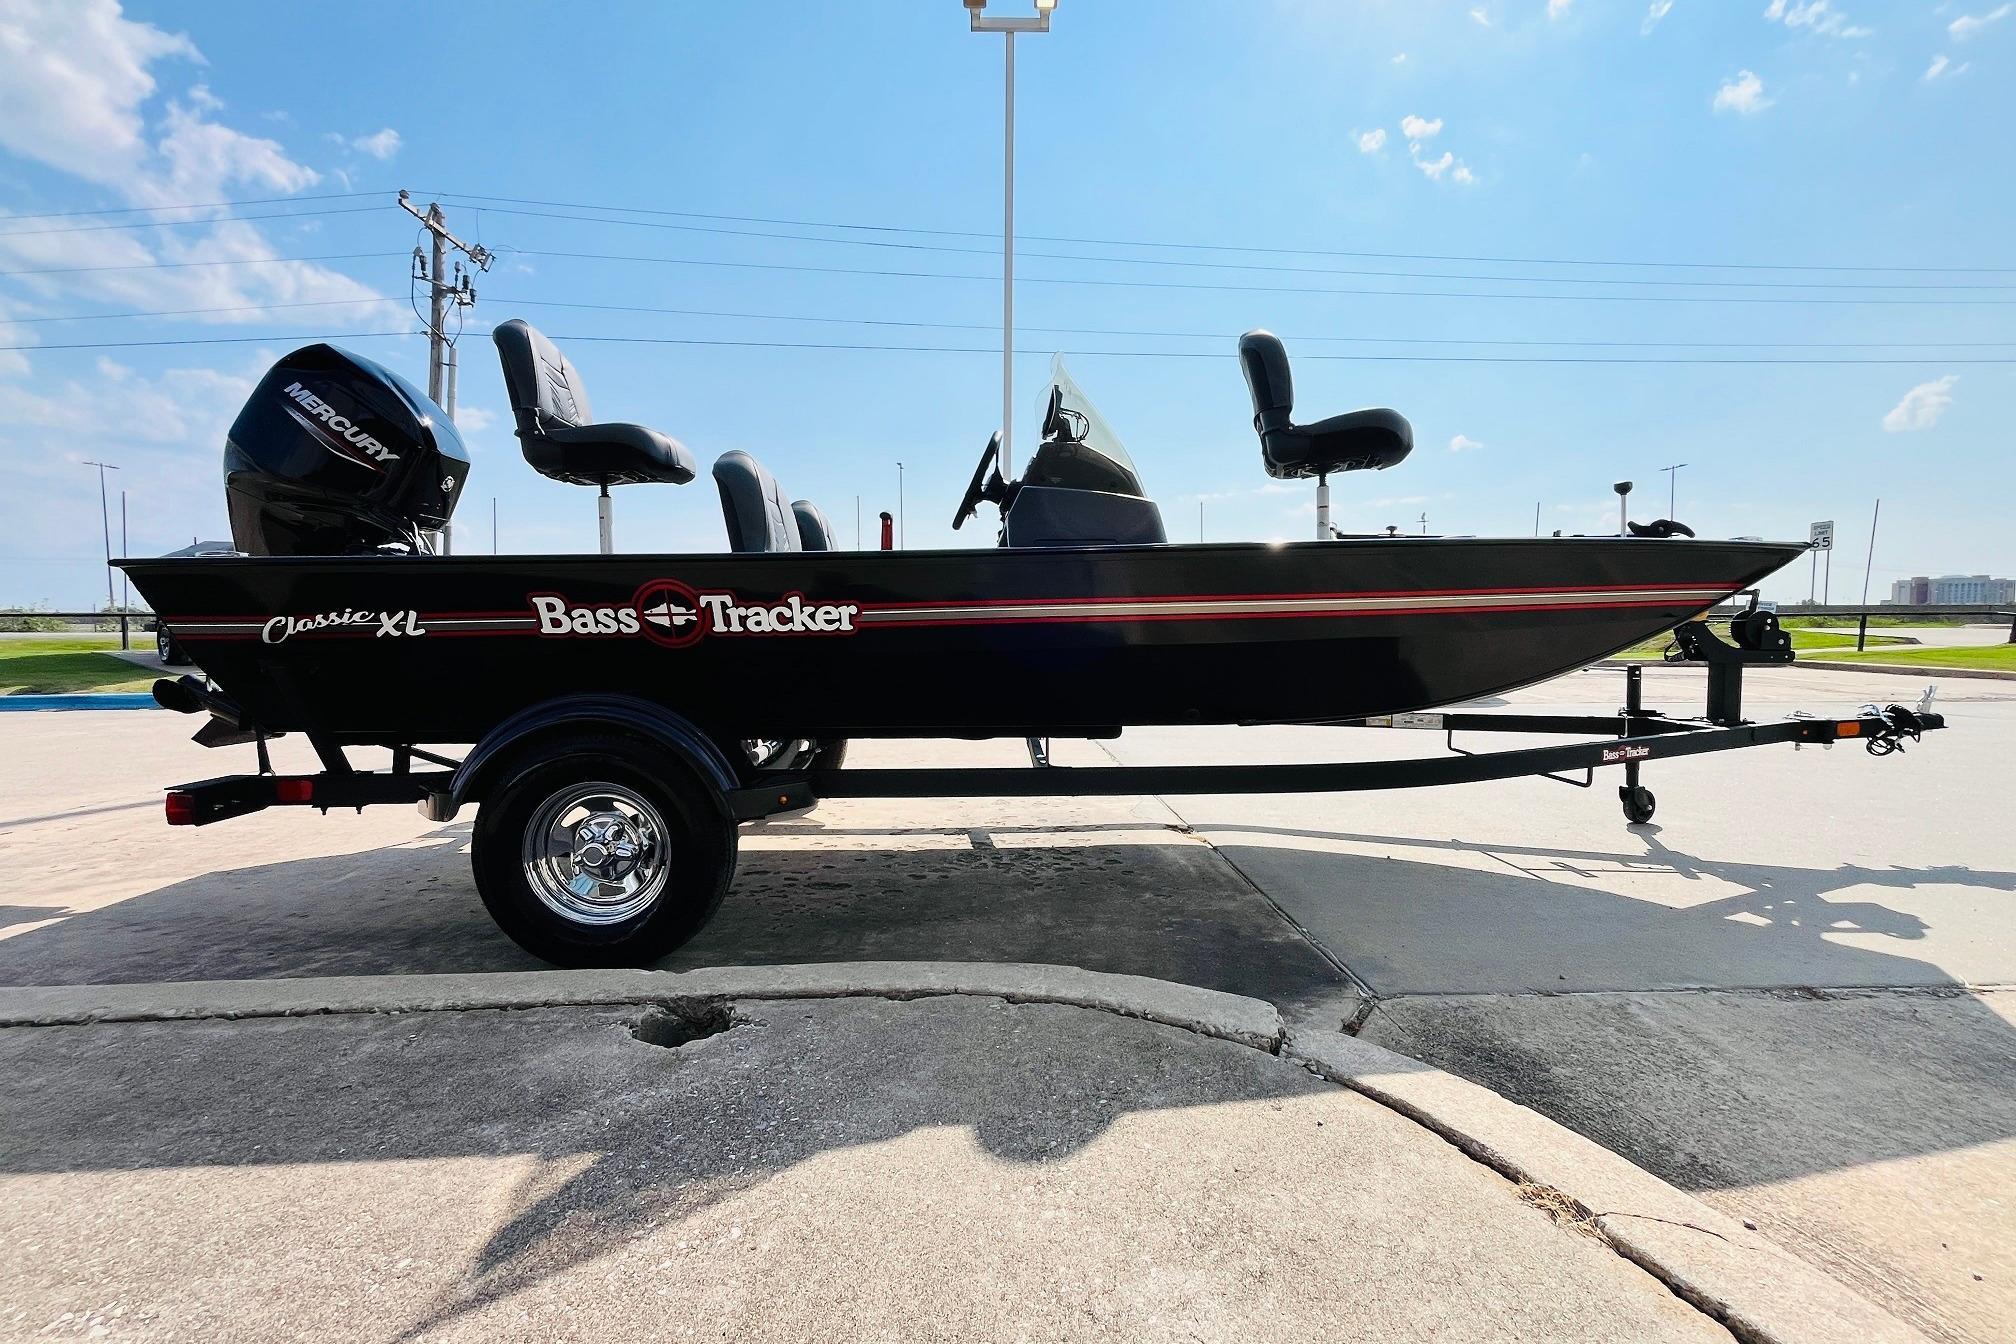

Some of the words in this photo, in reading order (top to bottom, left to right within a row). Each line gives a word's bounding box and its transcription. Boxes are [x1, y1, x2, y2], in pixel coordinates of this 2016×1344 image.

[284, 381, 400, 462] MERCURY
[1811, 536, 1831, 549] 65
[262, 608, 375, 644] Classic
[376, 610, 426, 638] XL
[532, 596, 641, 634] Bass
[699, 595, 858, 633] Tracker
[1602, 749, 1620, 761] Bass
[1625, 746, 1650, 758] Tracker
